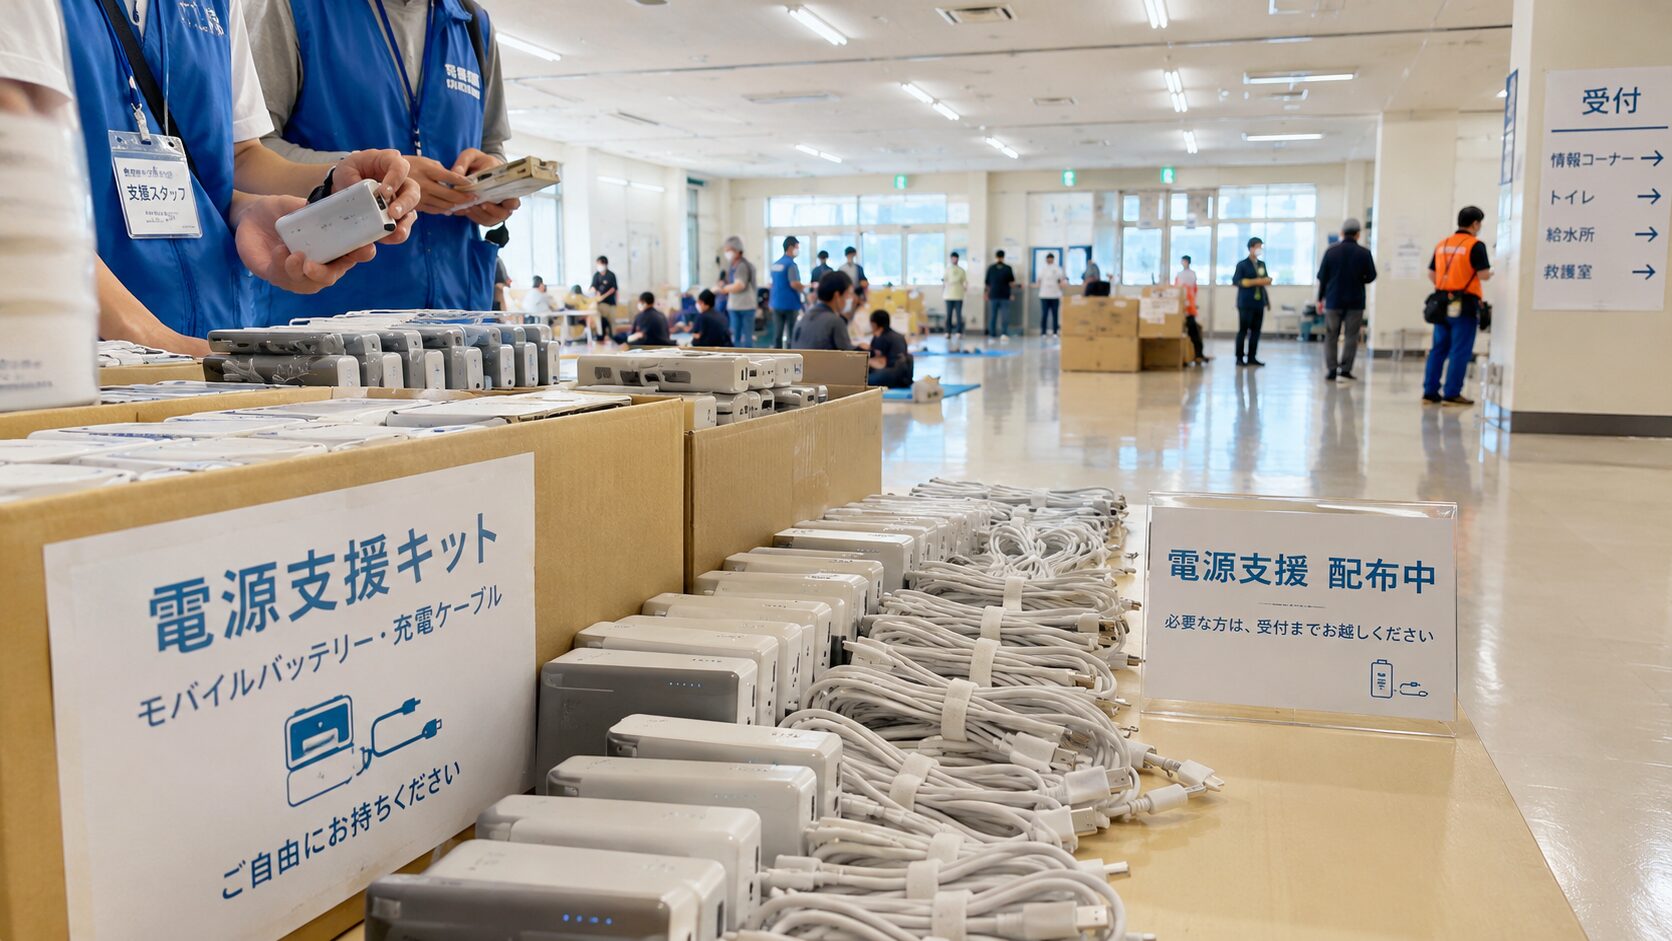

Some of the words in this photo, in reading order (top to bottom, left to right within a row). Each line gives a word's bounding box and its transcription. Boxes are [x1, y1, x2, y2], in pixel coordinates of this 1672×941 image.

[1582, 86, 1642, 116] 受付
[1550, 152, 1635, 168] 情報コーナー
[1551, 190, 1595, 205] トイレ
[1546, 226, 1595, 242] 給水所
[1543, 263, 1593, 280] 救護室
[148, 512, 499, 654] 電源支援キット
[1167, 549, 1309, 588] 電源支援
[1328, 556, 1436, 594] 配布中
[1164, 613, 1434, 643] 必要な方は、受付までお越しください
[137, 583, 503, 728] モバイルバッテリー・充電ケーブル
[221, 760, 463, 900] ご自由にお持ちください
